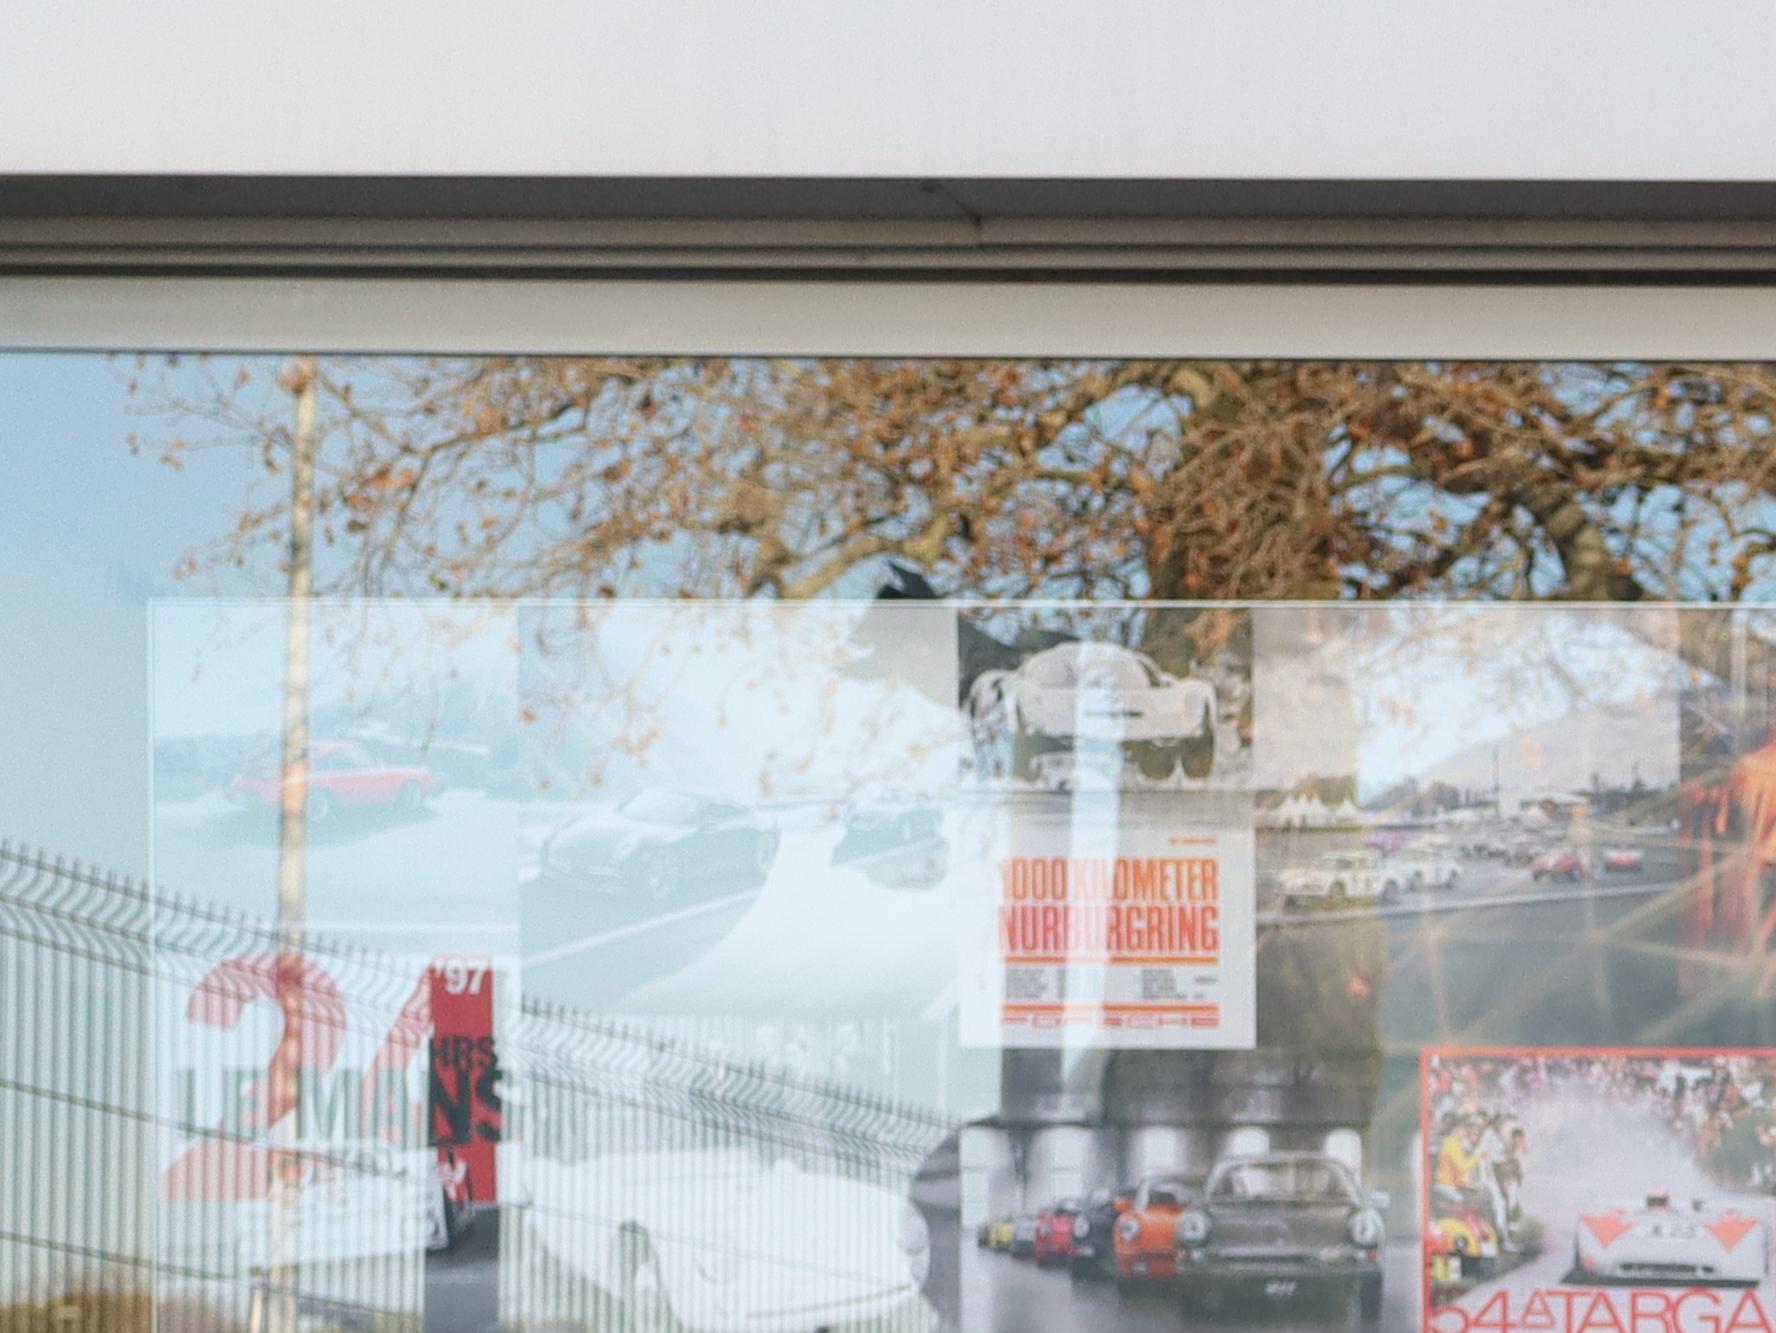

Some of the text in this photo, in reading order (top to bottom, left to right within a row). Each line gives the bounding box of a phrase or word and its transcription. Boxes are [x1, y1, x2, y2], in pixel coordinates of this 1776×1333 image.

[999, 857, 1218, 901] 1000 KILOMETER
[434, 957, 486, 994] '97
